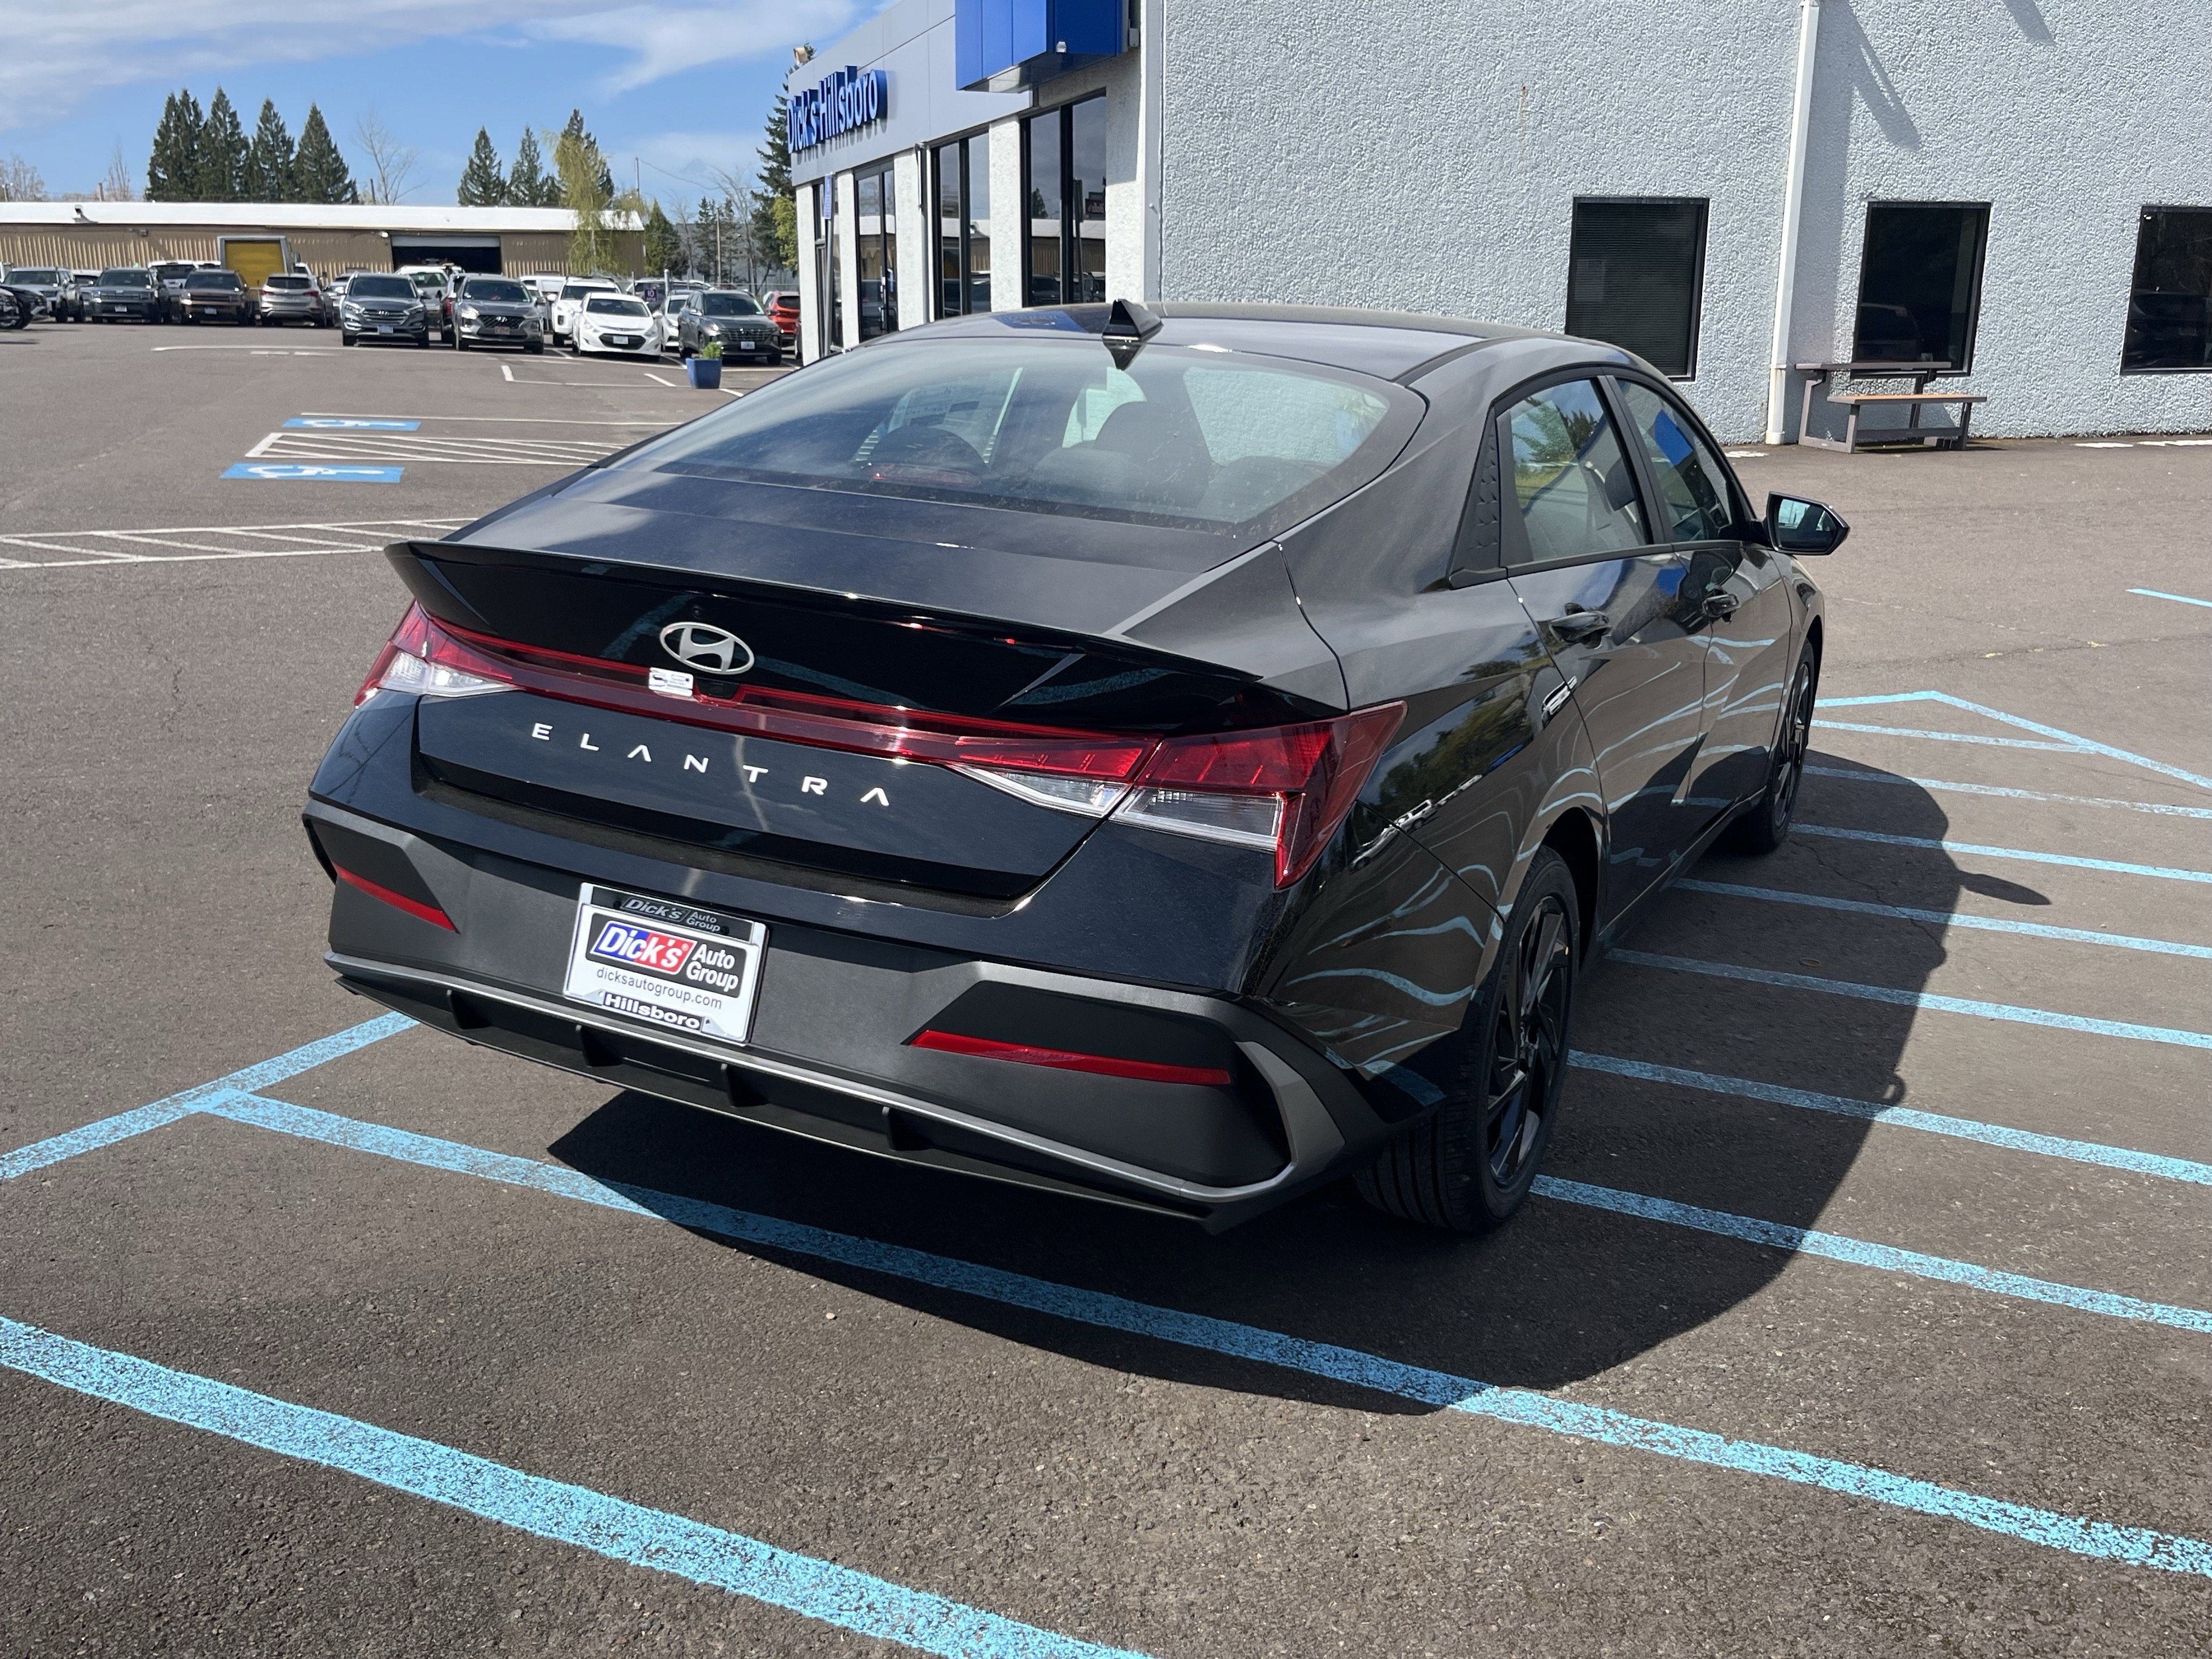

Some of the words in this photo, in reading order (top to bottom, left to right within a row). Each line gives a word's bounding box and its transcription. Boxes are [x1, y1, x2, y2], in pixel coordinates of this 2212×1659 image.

[786, 89, 817, 154] Dick's
[819, 65, 880, 141] Hillsboro
[531, 722, 890, 806] ELANTRA
[624, 898, 683, 920] Dick's
[689, 911, 718, 924] Auto
[686, 917, 721, 933] Group
[598, 926, 684, 969] Dick's
[691, 943, 736, 970] Auto
[596, 966, 723, 1009] dicksautogroup.com
[686, 961, 739, 992] Group
[604, 992, 701, 1030] Hillsboro
